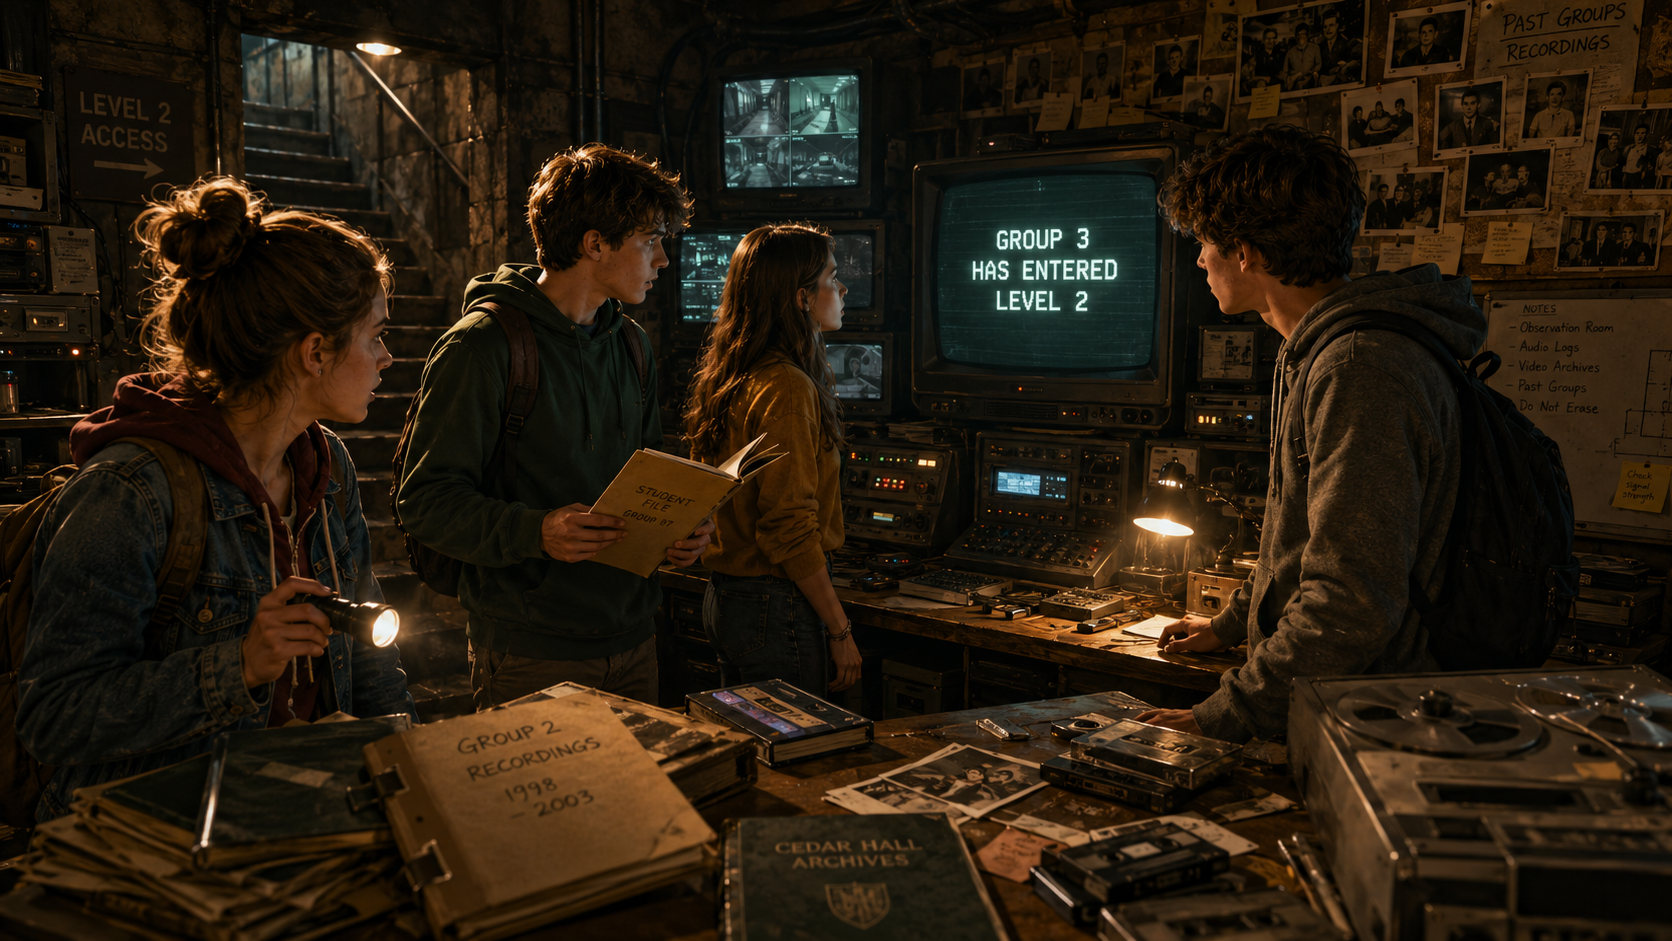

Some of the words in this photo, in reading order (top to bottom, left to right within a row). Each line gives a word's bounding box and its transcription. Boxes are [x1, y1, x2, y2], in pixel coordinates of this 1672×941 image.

[1503, 12, 1550, 36] PAST
[1557, 2, 1627, 28] GROUPS
[1506, 34, 1610, 62] RECORDINGS
[79, 90, 150, 122] LEVEL
[158, 101, 172, 125] 2
[80, 123, 168, 153] ACCESS
[996, 228, 1063, 251] GROUP
[1076, 227, 1090, 250] 3
[971, 259, 1010, 281] HAS
[1022, 258, 1118, 281] ENTERED
[996, 290, 1061, 311] LEVEL
[1075, 290, 1088, 312] 2
[1522, 304, 1557, 314] NOTES
[1520, 321, 1580, 334] Observation
[1585, 320, 1614, 334] Room
[1519, 340, 1549, 353] Audio
[1554, 341, 1580, 358] Logs
[1518, 359, 1548, 372] Video
[1553, 360, 1600, 374] Archives
[1518, 378, 1543, 392] Past
[1548, 379, 1587, 398] Groups
[1519, 399, 1534, 412] Do
[1540, 400, 1560, 413] Not
[1566, 401, 1599, 415] Erase
[635, 485, 696, 507] STUDENT
[641, 498, 672, 513] FILE
[622, 509, 658, 524] GROUP
[457, 725, 535, 755] GROUP
[541, 720, 562, 735] 2
[466, 736, 601, 782] RECORDINGS
[504, 777, 558, 803] 1998
[533, 789, 594, 818] 2003
[774, 840, 852, 854] CEDAR
[860, 838, 923, 851] HALL
[791, 853, 910, 870] ARCHIVES
